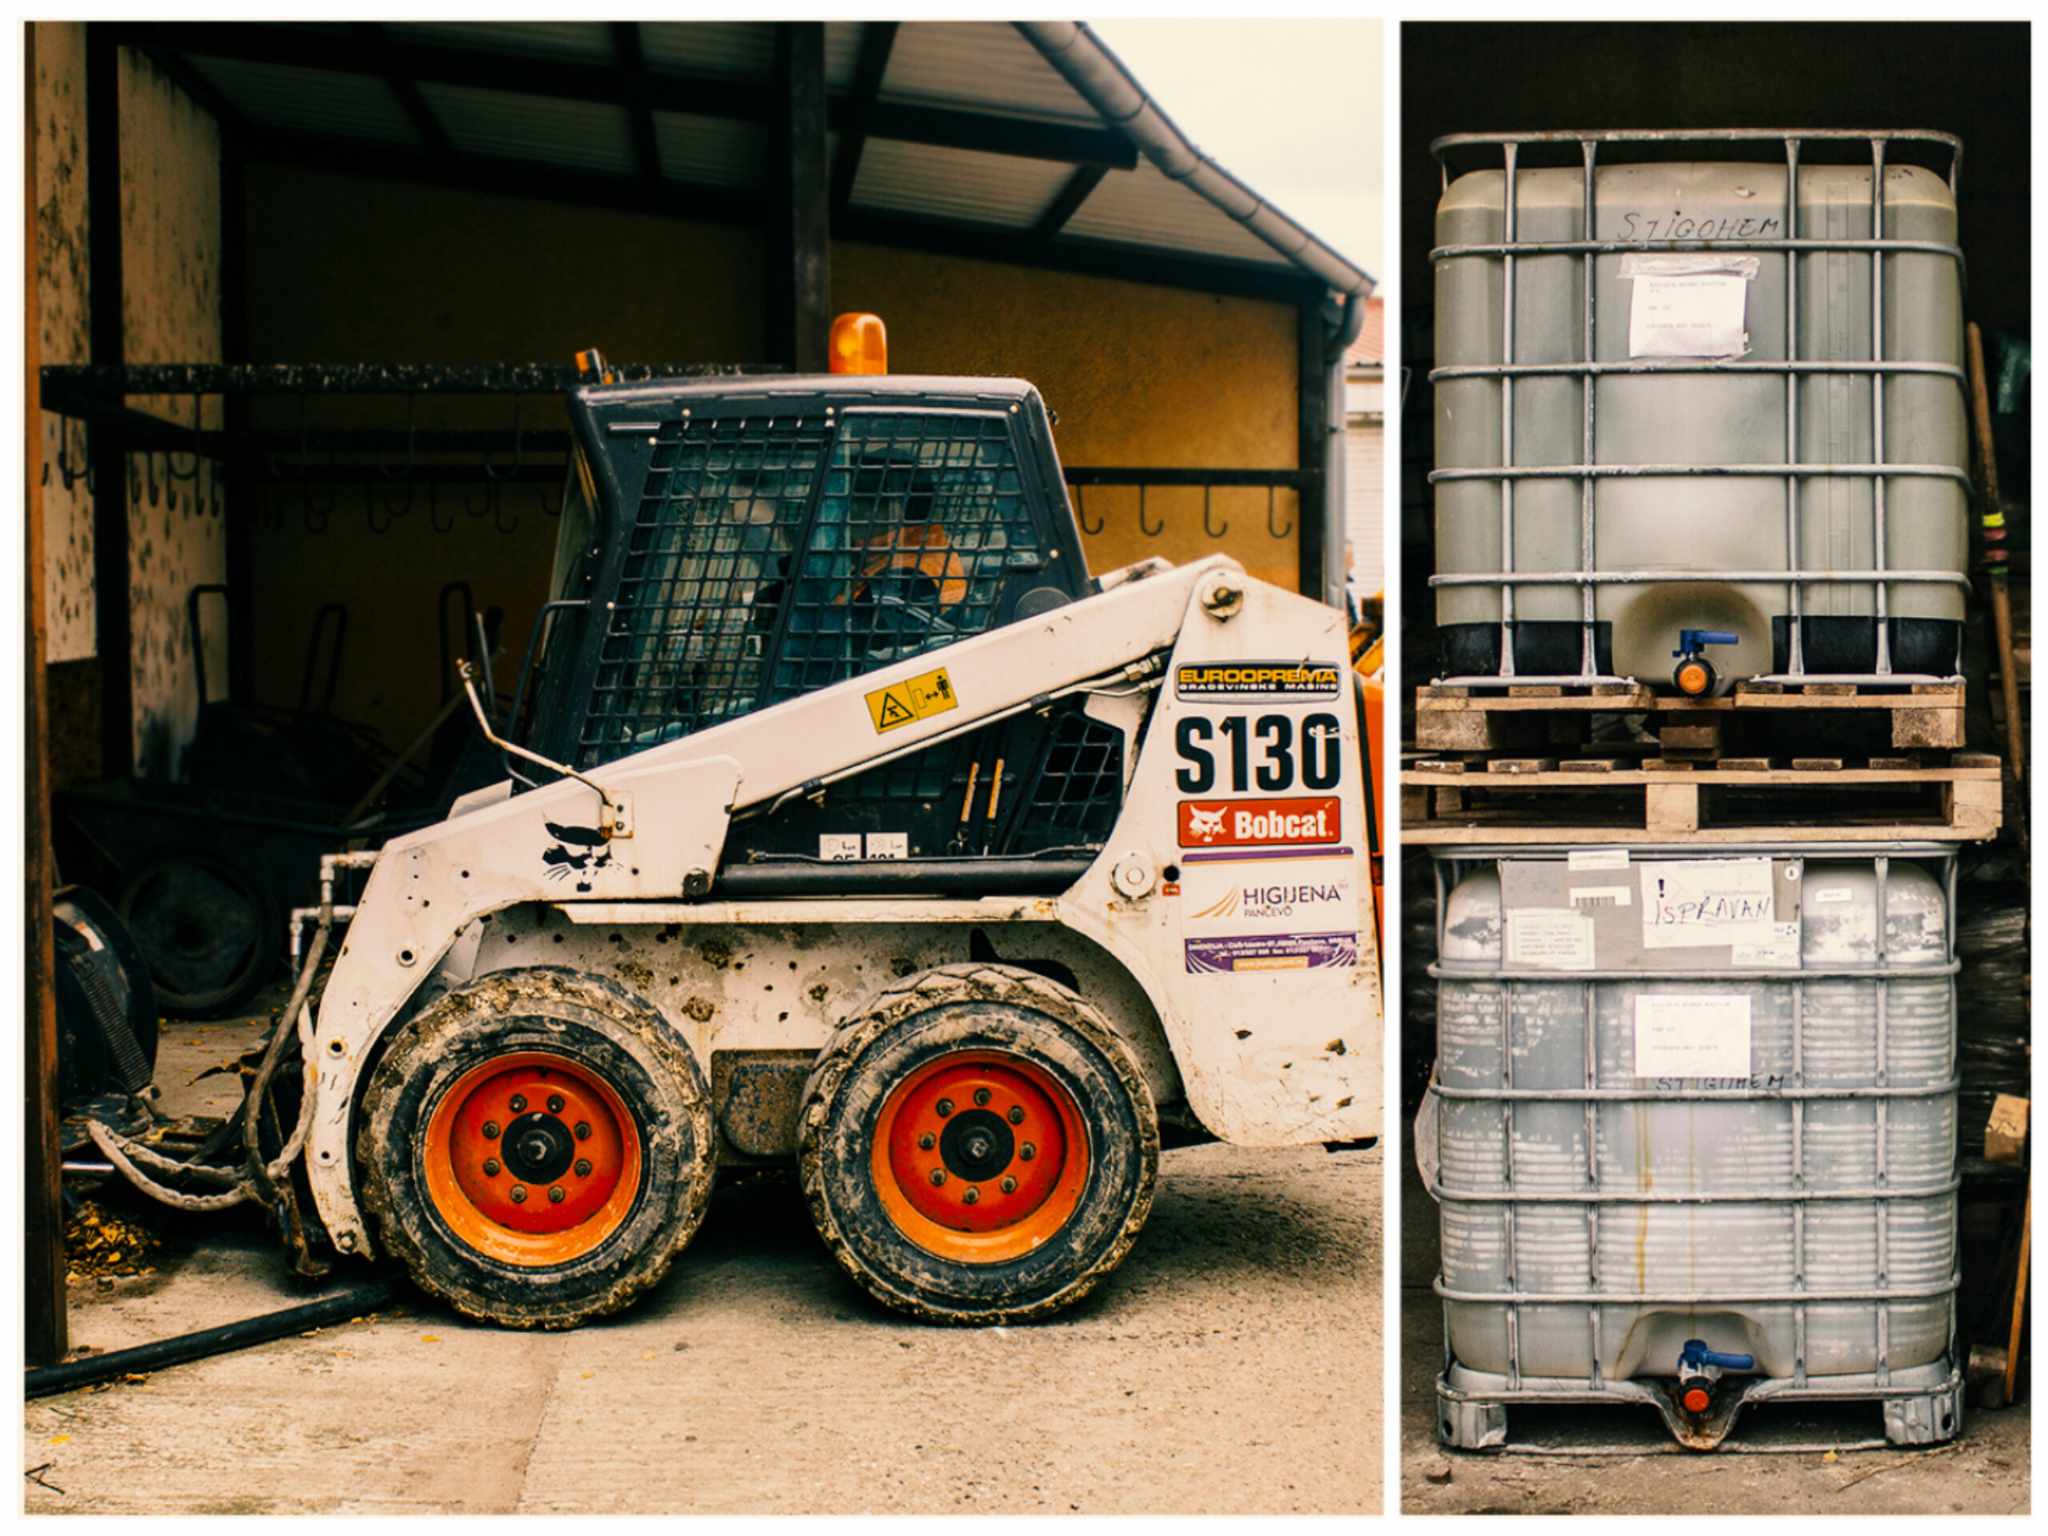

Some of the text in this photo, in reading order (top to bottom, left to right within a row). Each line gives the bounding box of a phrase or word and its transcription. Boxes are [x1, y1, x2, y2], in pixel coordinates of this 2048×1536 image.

[1179, 669, 1338, 683] EUROOPREMA
[1175, 713, 1341, 794] S130
[1243, 885, 1342, 905] HIGIJENA
